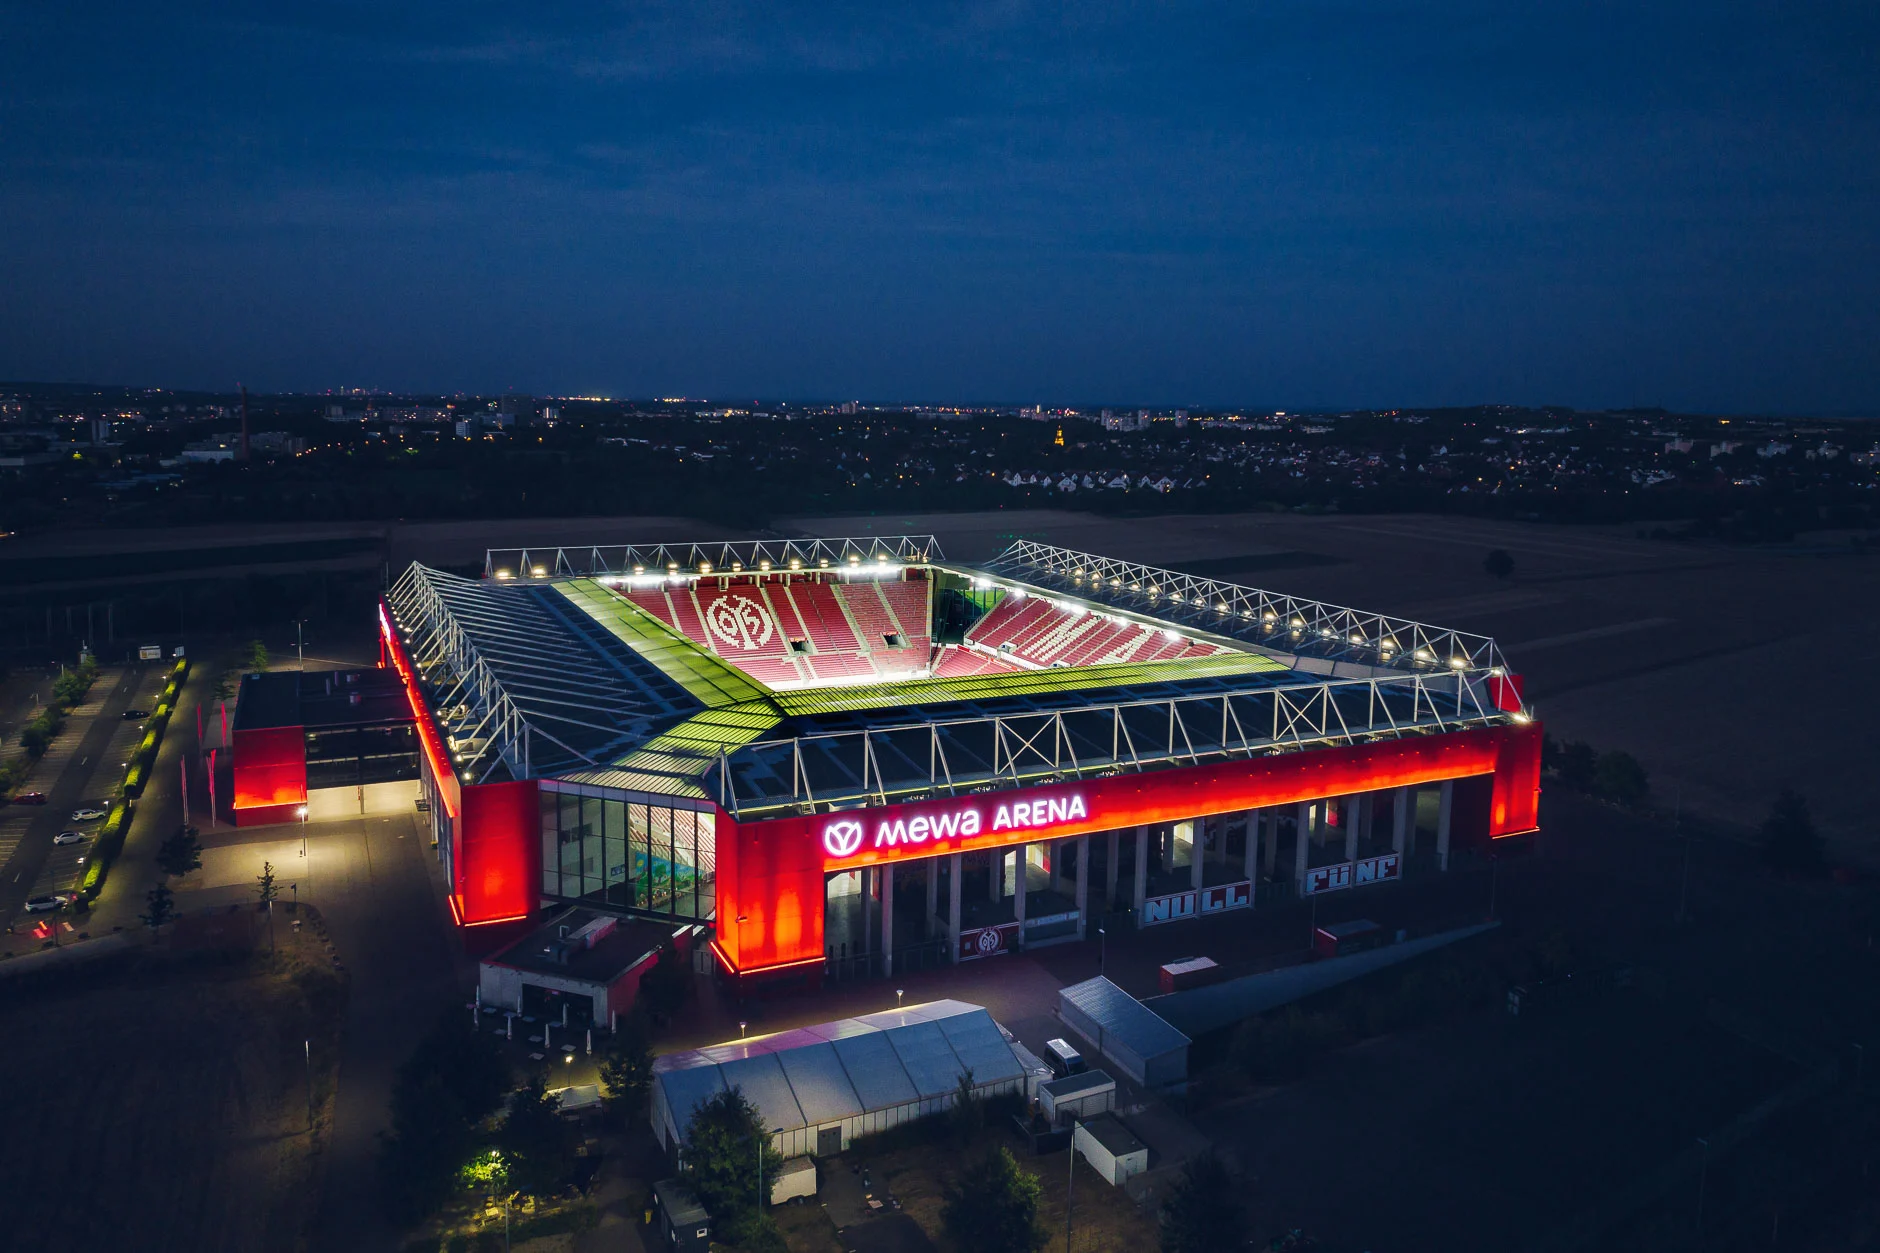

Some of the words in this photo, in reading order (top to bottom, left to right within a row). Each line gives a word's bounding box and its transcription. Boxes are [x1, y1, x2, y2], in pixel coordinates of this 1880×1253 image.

[993, 797, 1086, 831] ARENA
[1145, 887, 1247, 923] NULL
[1307, 857, 1396, 893] FÜNF
